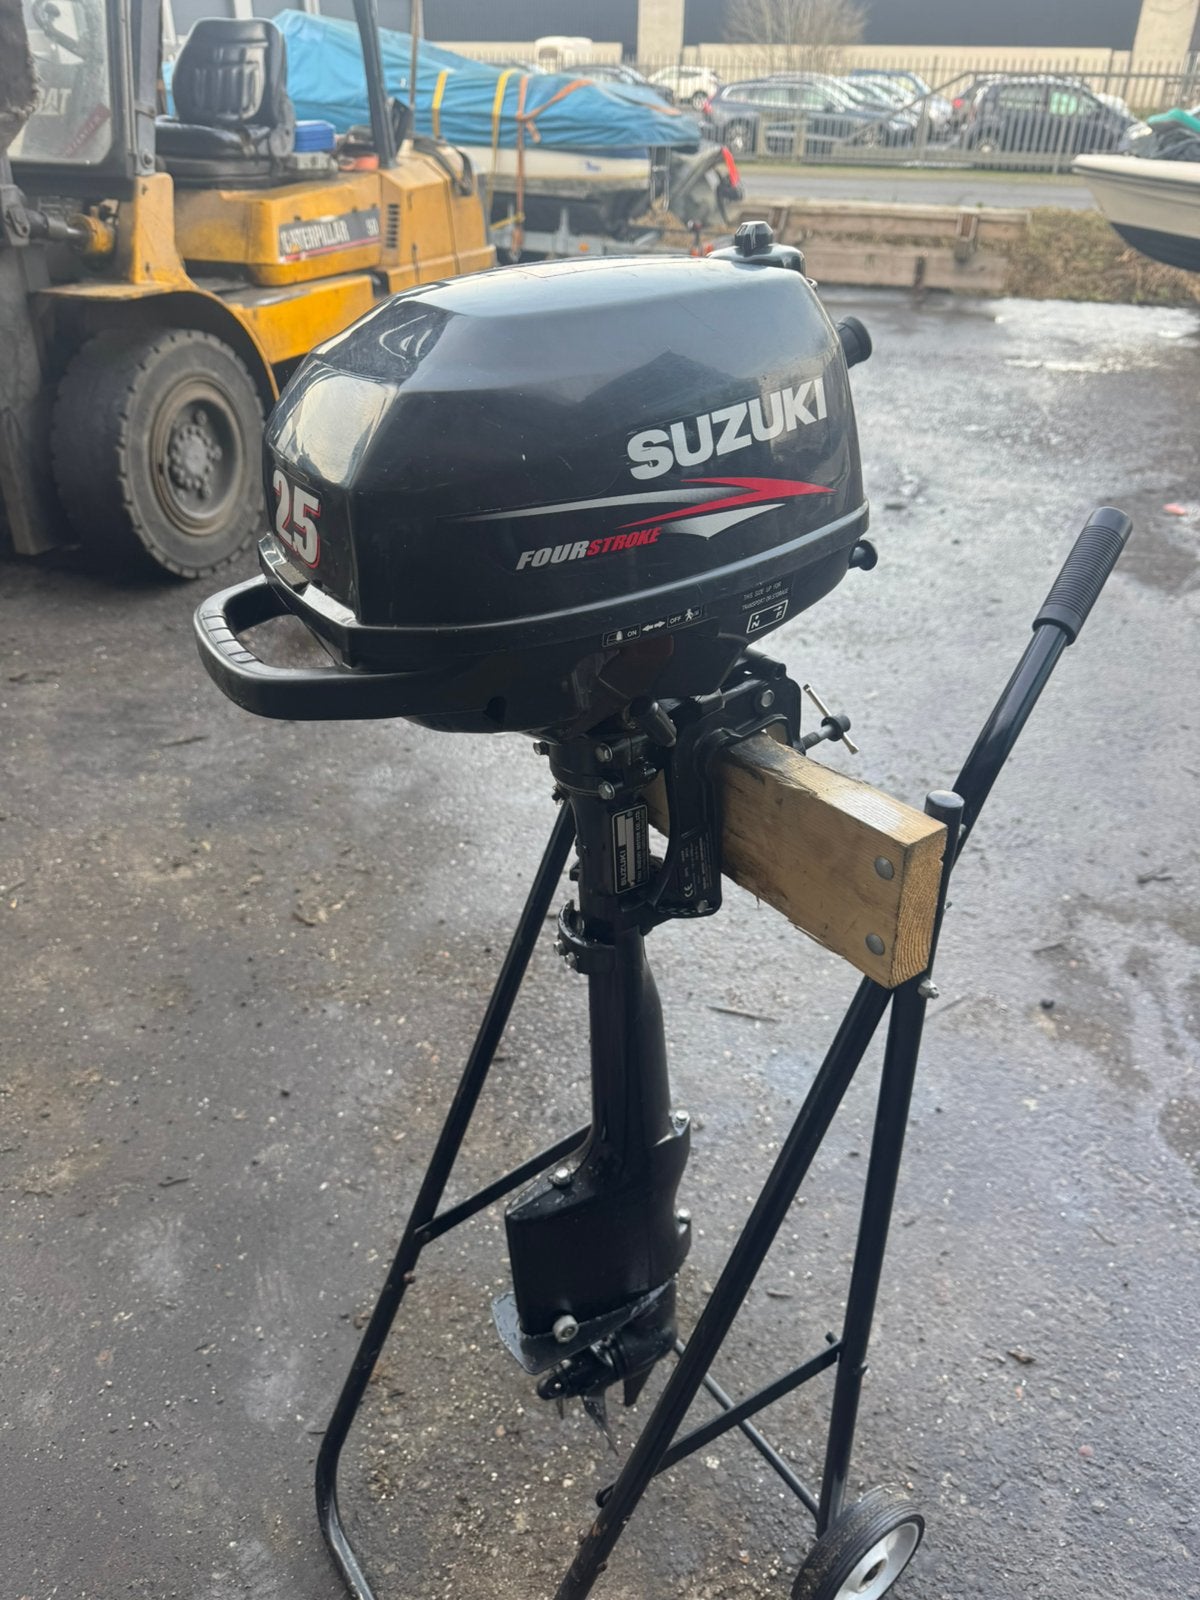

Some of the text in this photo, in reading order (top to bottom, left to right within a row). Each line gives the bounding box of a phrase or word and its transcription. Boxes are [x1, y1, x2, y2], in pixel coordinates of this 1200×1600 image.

[280, 220, 350, 254] CATERPILLAR
[627, 376, 828, 480] SUZUKI
[669, 615, 682, 625] OFF
[751, 619, 760, 629] N
[627, 629, 637, 638] ON
[619, 849, 628, 887] SUZUKI
[683, 883, 694, 899] CE
